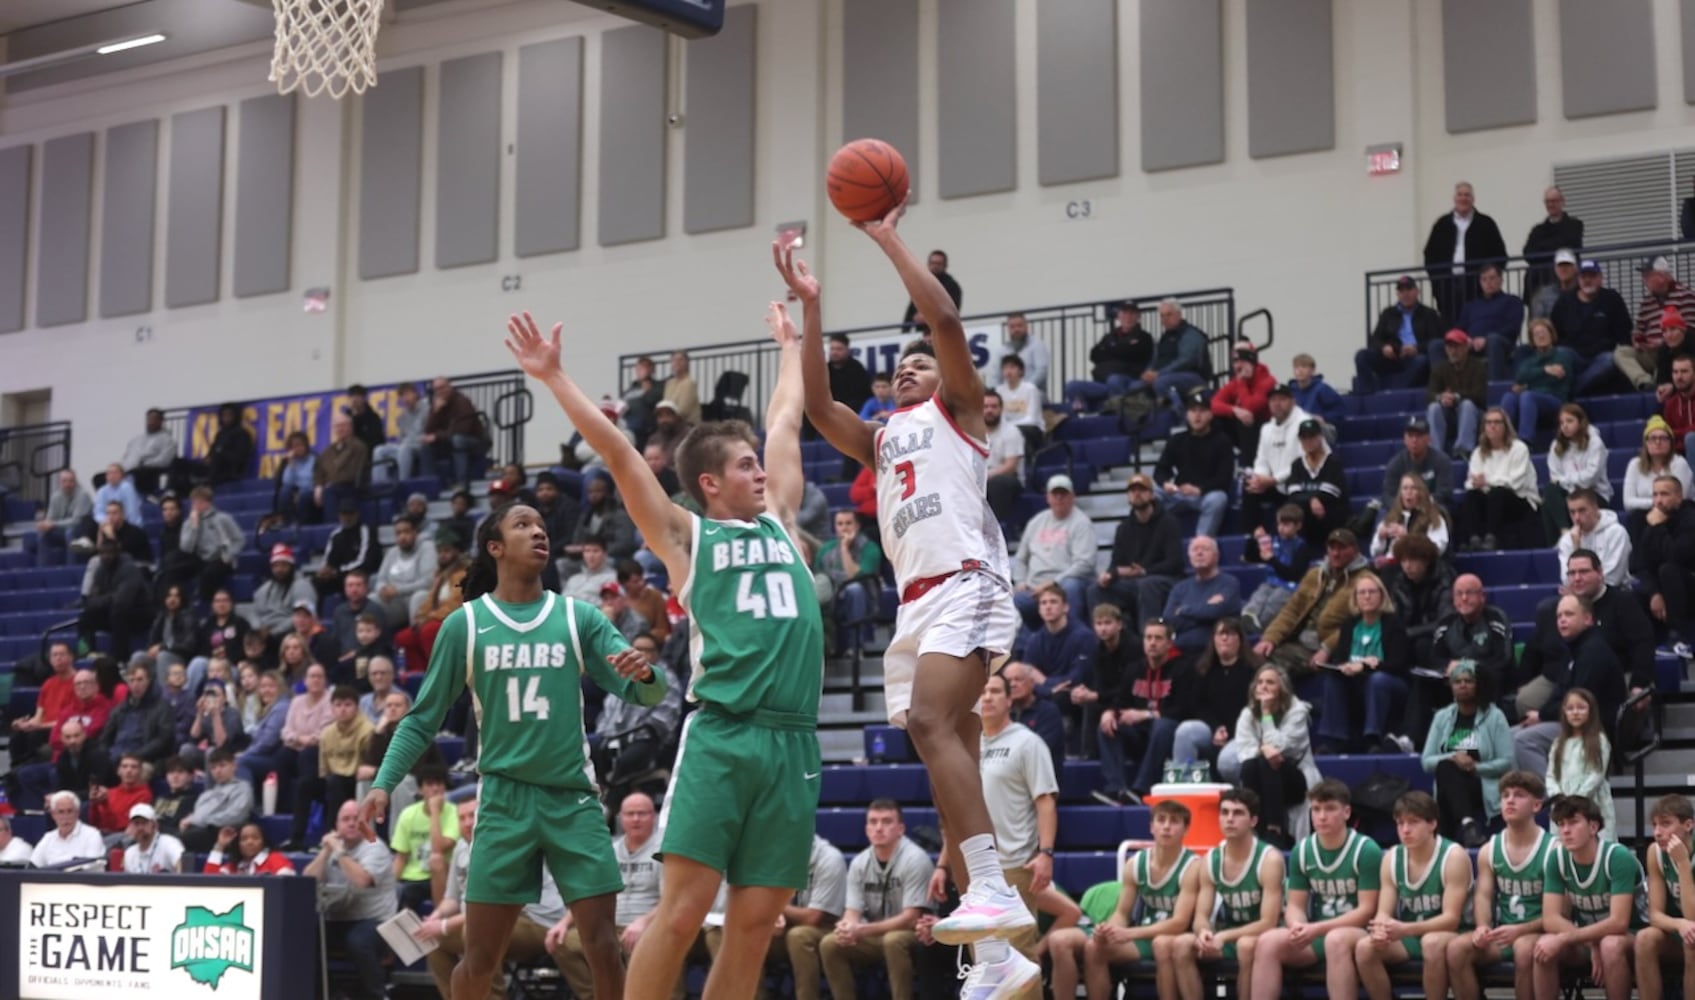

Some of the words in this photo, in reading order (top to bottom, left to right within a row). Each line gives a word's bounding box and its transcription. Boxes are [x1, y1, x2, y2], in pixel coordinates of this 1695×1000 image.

[1066, 201, 1091, 219] C3
[501, 275, 521, 291] C2
[266, 399, 321, 451] EAT
[895, 460, 916, 501] 3
[892, 492, 942, 539] BEARS
[713, 537, 795, 572] BEARS
[736, 571, 799, 619] 40
[484, 642, 566, 672] BEARS
[506, 675, 550, 722] 14
[30, 902, 152, 930] RESPECT
[1509, 895, 1526, 919] 4
[41, 933, 151, 972] GAME
[173, 925, 253, 966] OHSAA
